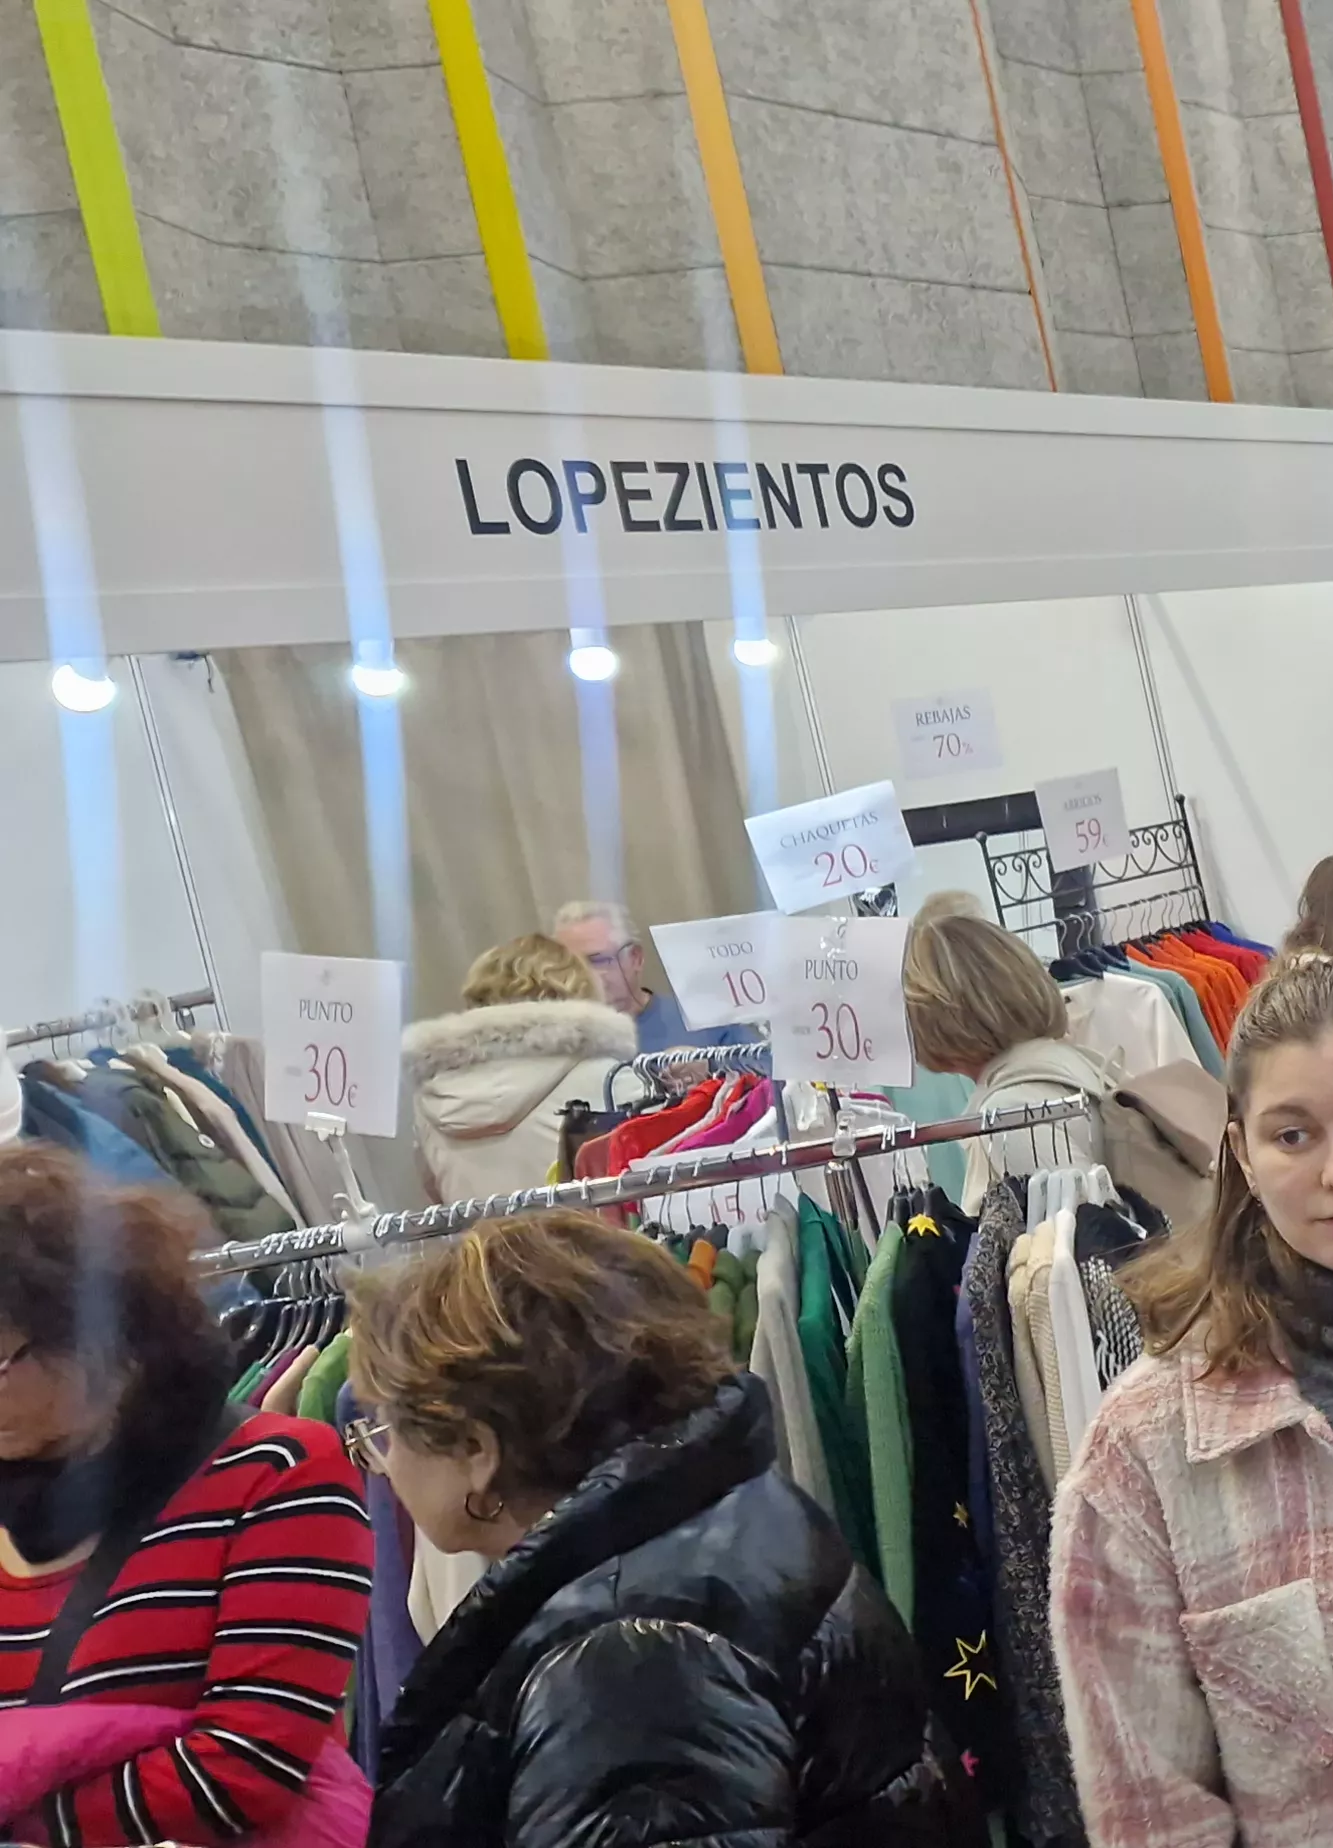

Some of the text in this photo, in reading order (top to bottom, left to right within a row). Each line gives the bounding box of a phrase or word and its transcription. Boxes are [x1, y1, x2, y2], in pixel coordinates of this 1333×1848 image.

[455, 458, 915, 535] LOPEZIENTOS
[915, 706, 971, 727] REBAJAS
[932, 733, 973, 759] 70%
[780, 811, 878, 850] CHAQUETAS
[814, 844, 880, 888] 20€
[708, 941, 754, 960] TODO
[722, 968, 766, 1009] 10
[804, 959, 859, 982] PUNTO
[299, 999, 353, 1024] PUNTO
[810, 1002, 875, 1062] 30€
[304, 1043, 358, 1108] 30€
